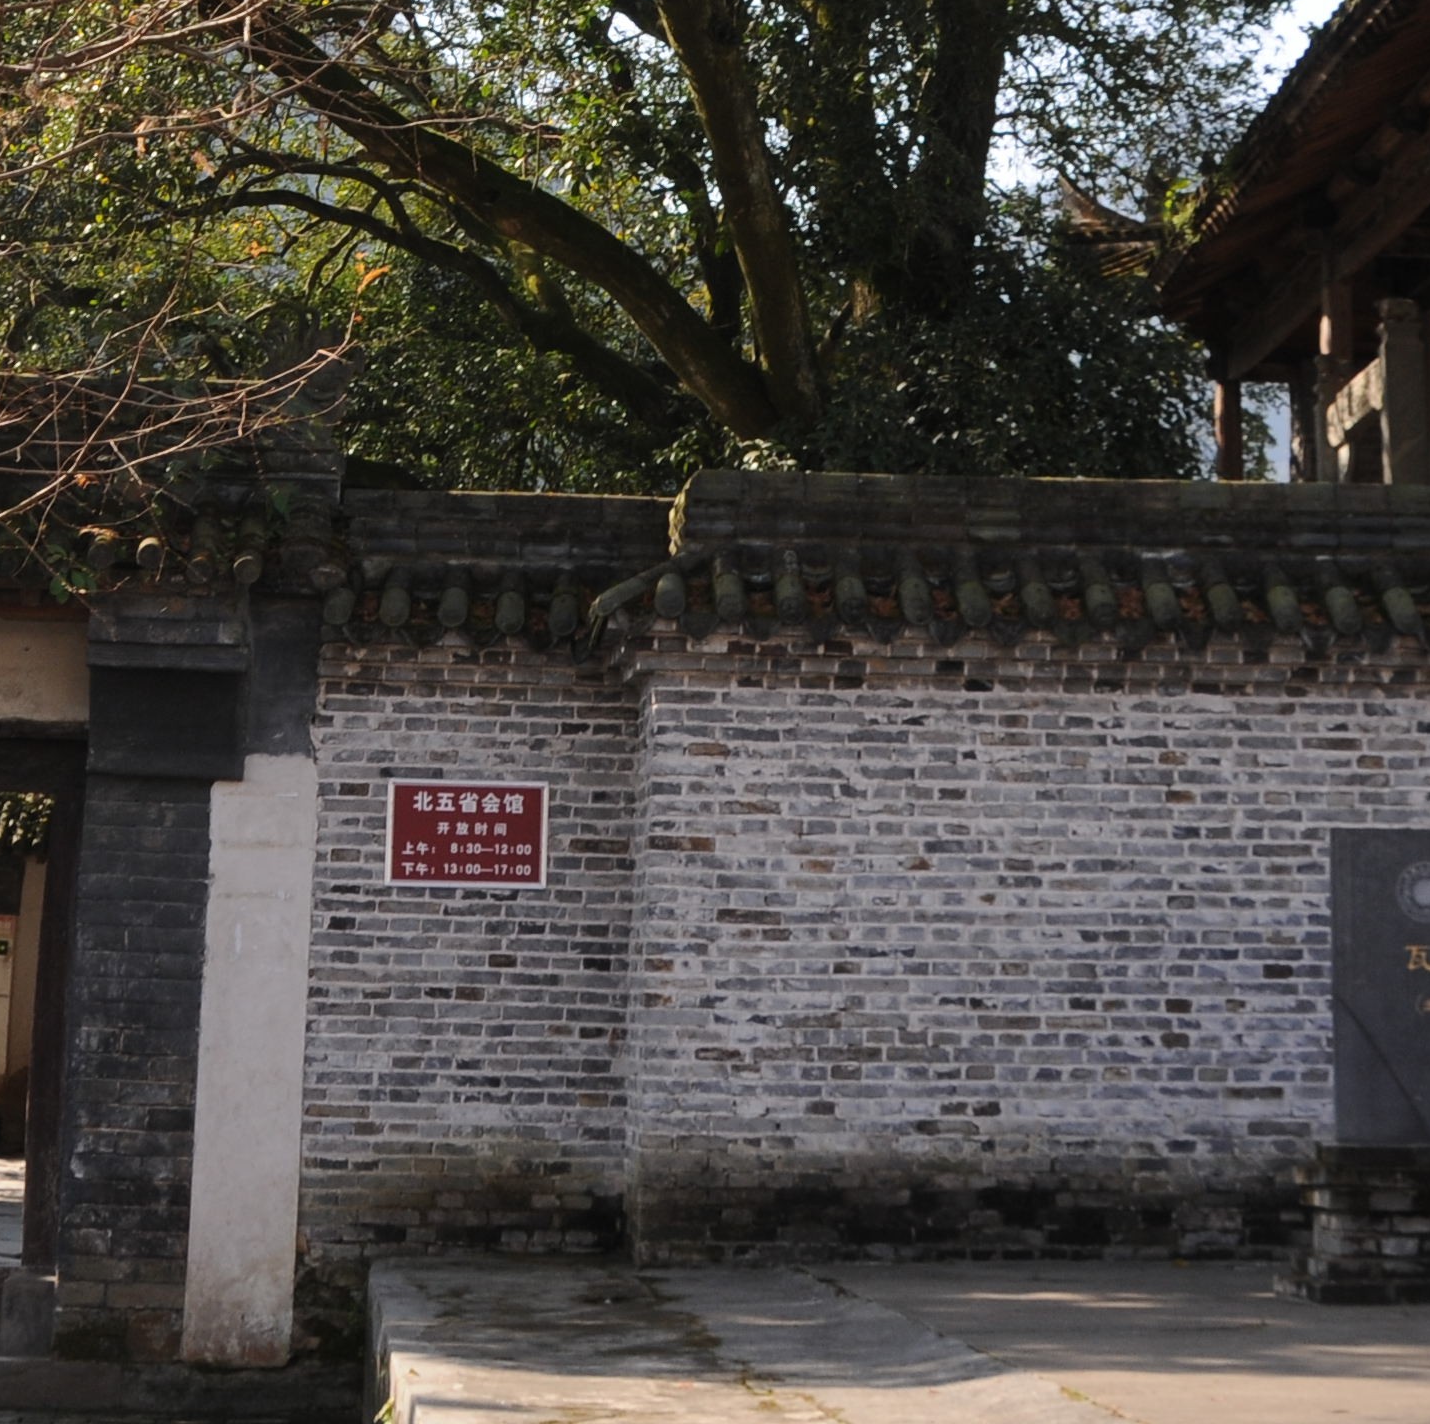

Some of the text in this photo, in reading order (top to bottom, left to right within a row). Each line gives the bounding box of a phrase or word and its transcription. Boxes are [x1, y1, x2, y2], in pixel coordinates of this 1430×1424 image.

[413, 791, 524, 814] 北五省会馆
[437, 821, 507, 837] 开放时间
